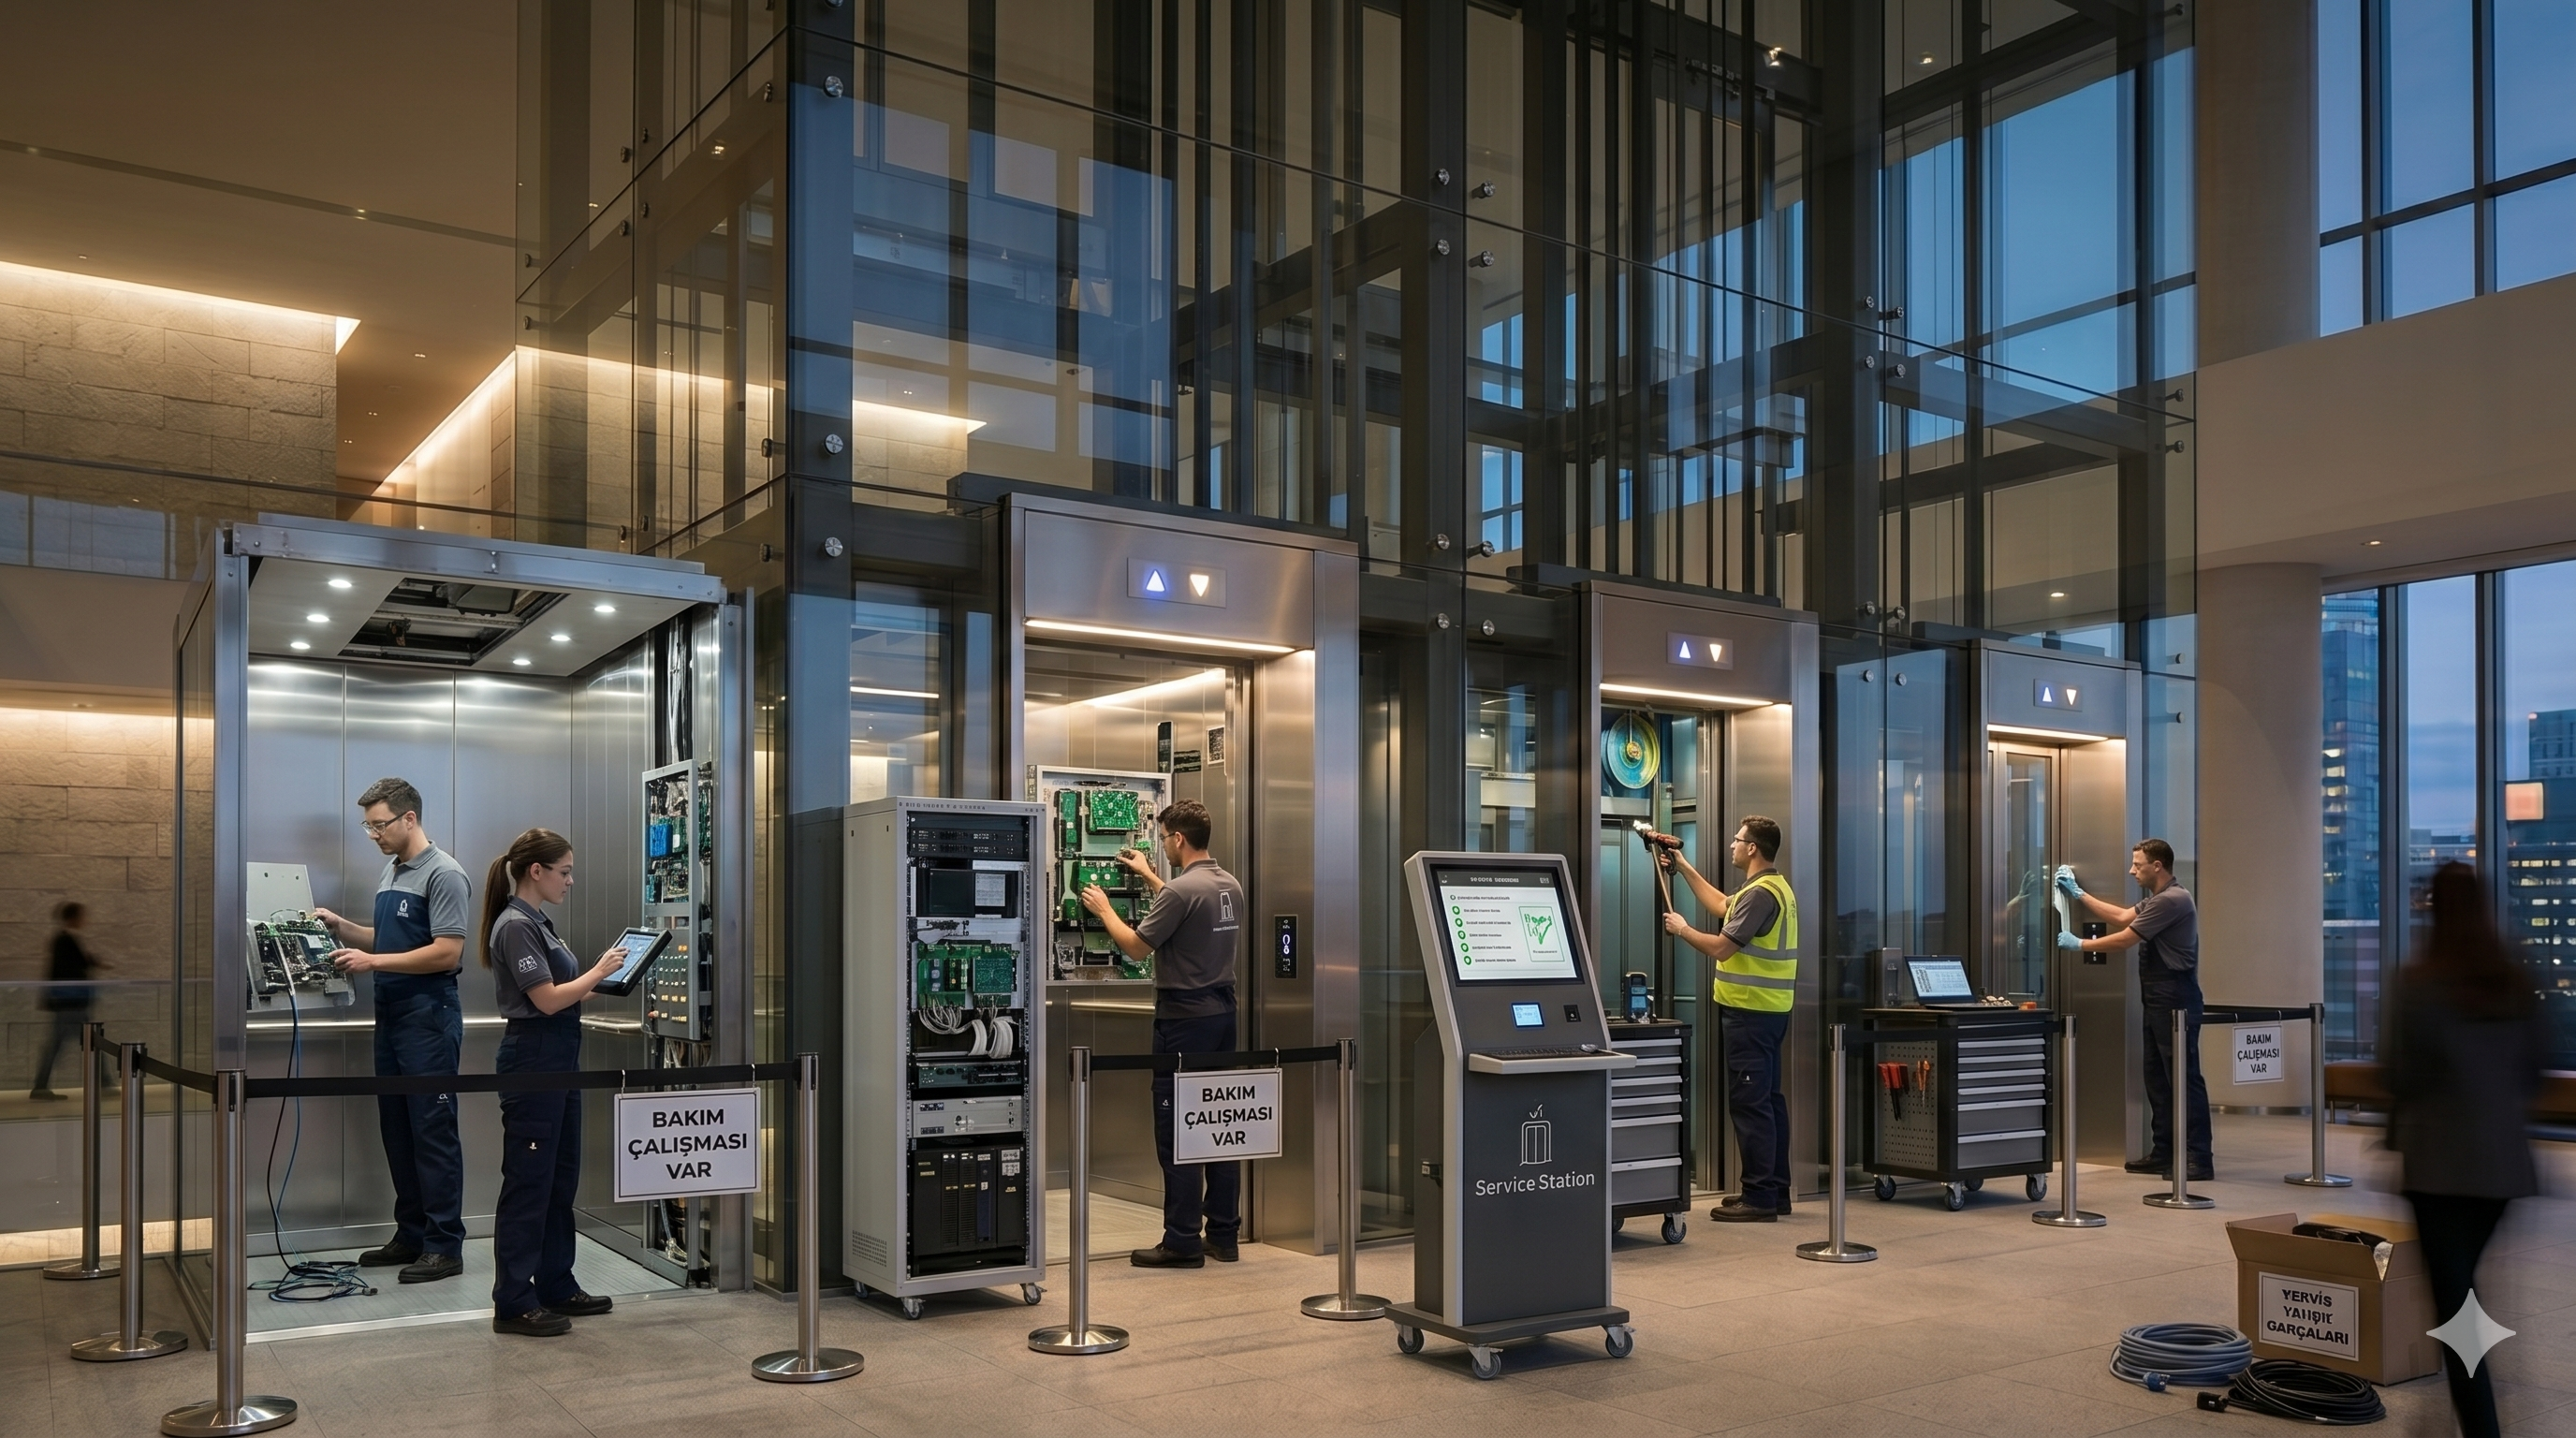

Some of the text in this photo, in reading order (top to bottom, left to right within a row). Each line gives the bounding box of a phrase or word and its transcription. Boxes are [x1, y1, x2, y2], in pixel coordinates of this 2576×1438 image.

[2250, 1064, 2267, 1074] VAR
[1202, 1085, 1255, 1103] BAKIM
[652, 1108, 724, 1128] BAKIM
[1184, 1107, 1272, 1130] ÇALIŞMASI
[628, 1133, 747, 1161] ÇALIŞMASI
[1211, 1131, 1246, 1147] VAR
[666, 1161, 712, 1180] VAR
[1475, 1170, 1595, 1196] Service Station
[2266, 1320, 2349, 1345] GARÇALARI
